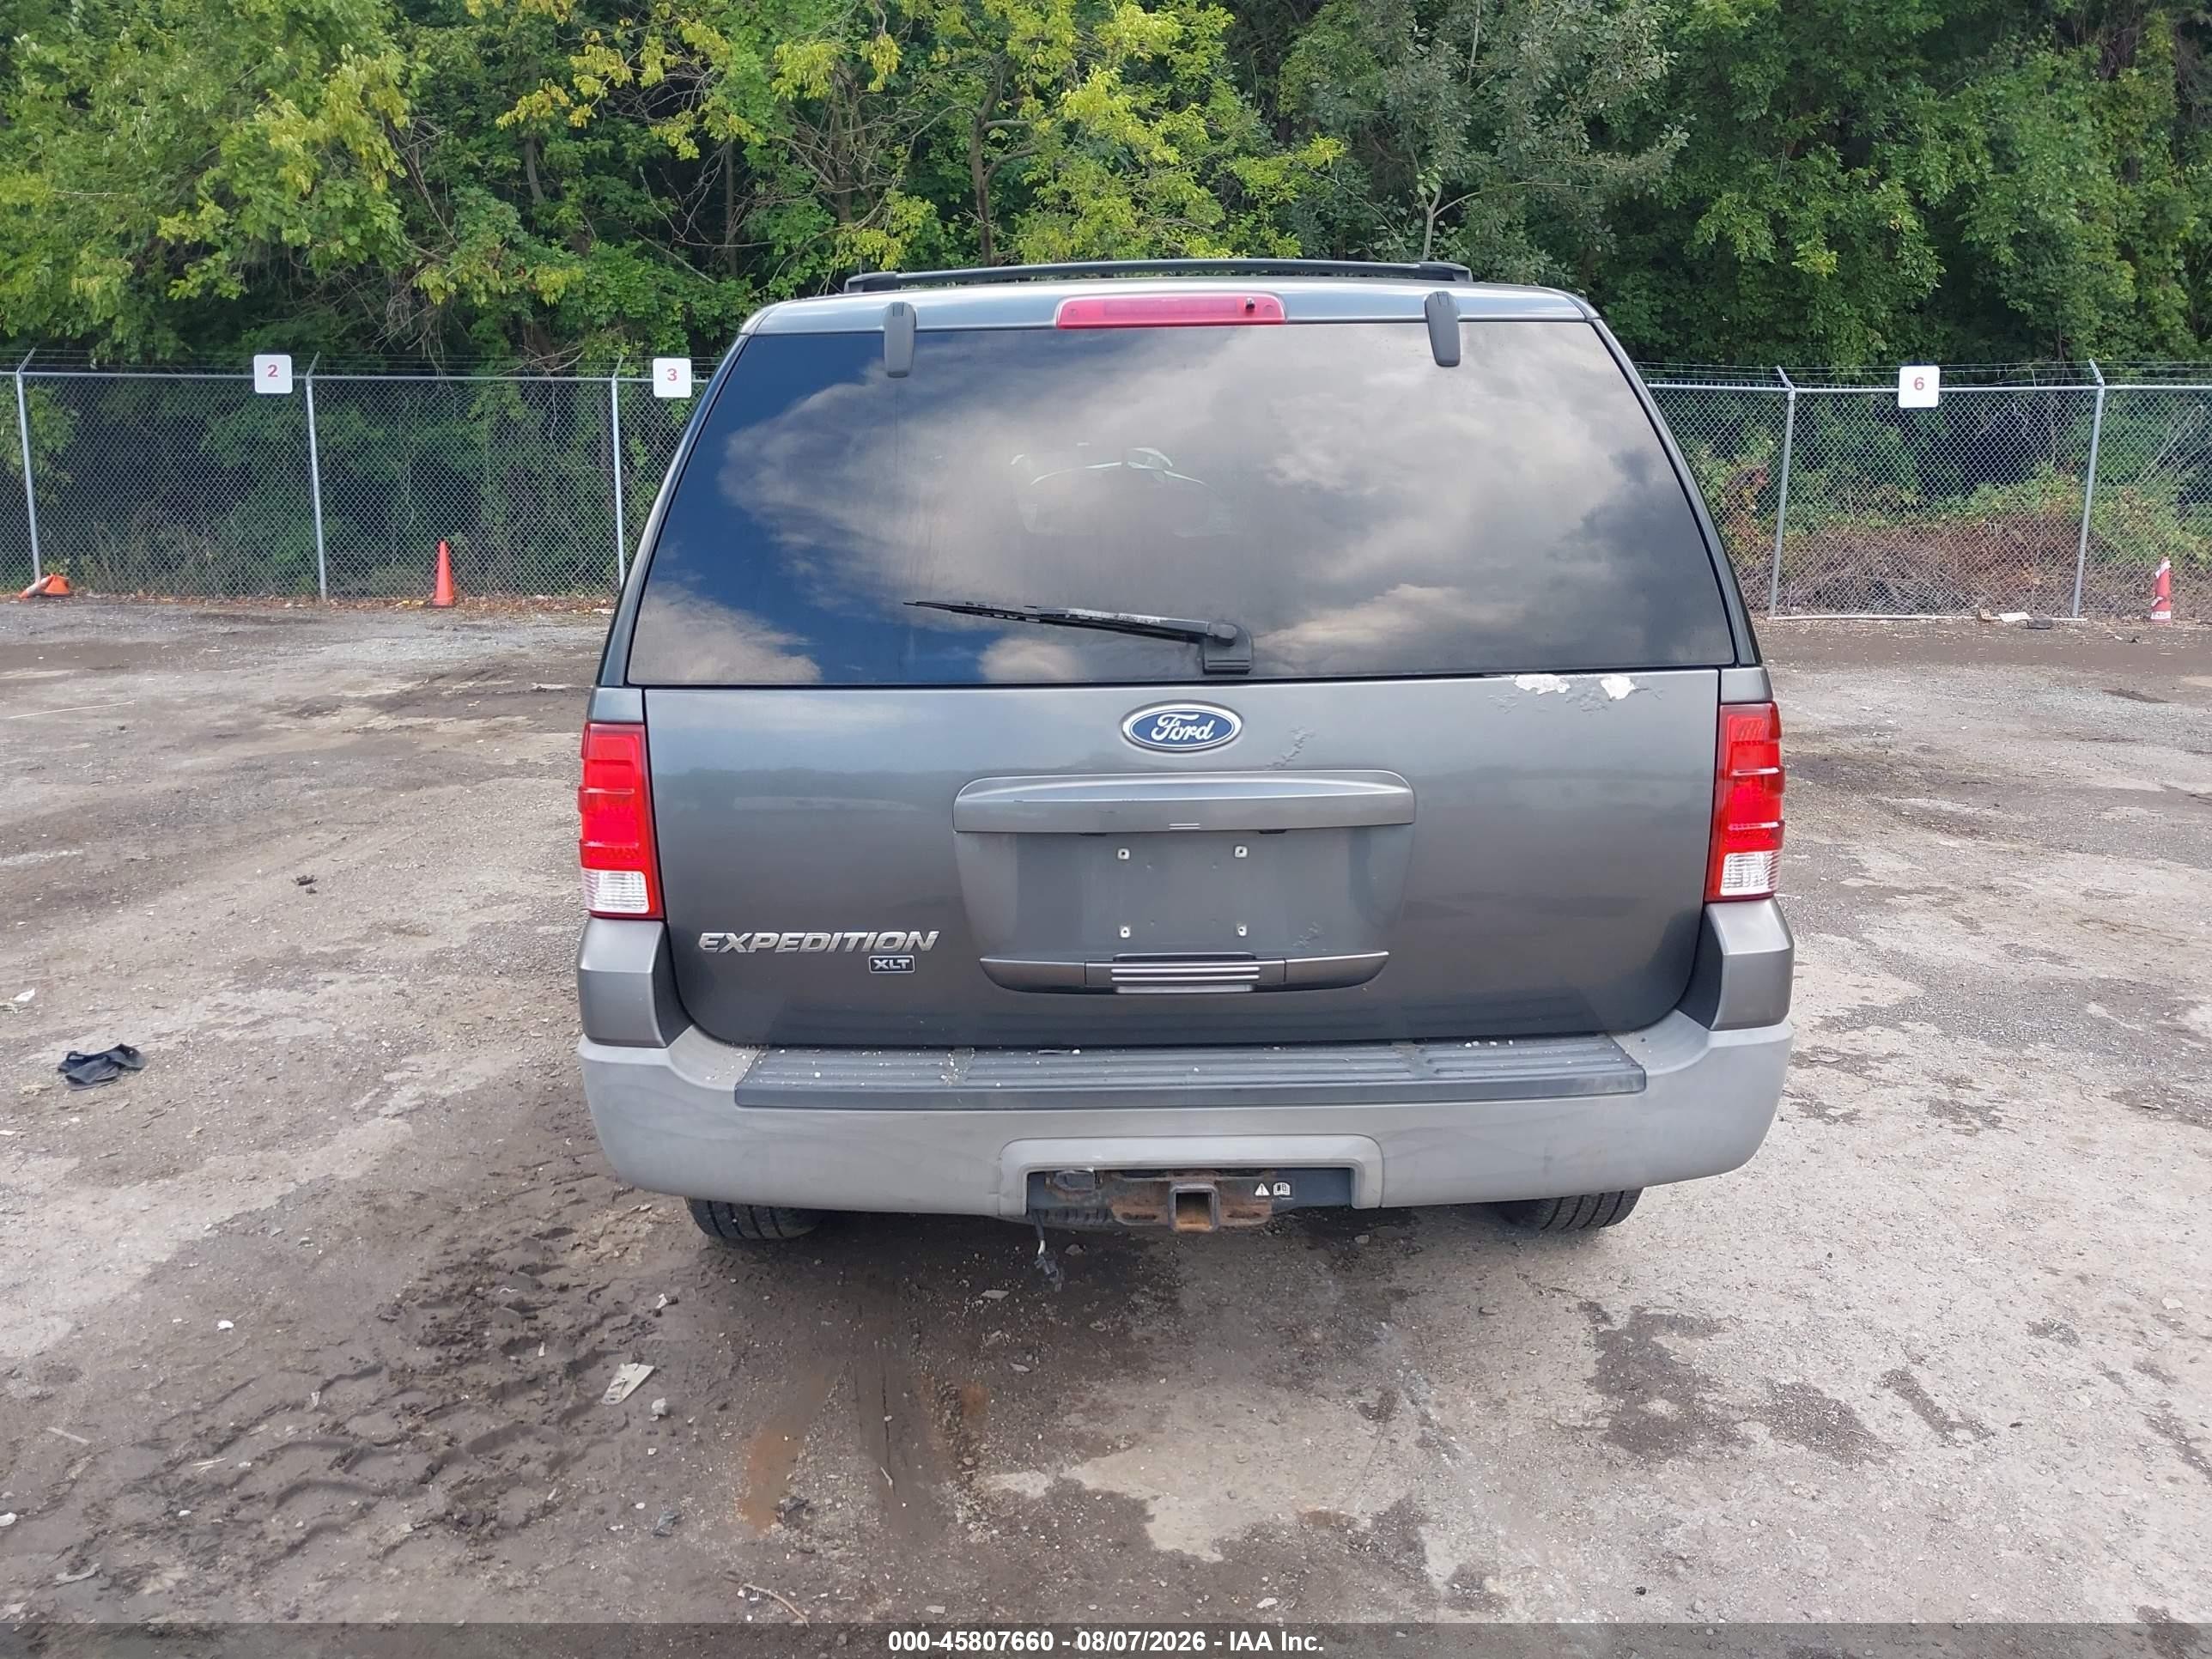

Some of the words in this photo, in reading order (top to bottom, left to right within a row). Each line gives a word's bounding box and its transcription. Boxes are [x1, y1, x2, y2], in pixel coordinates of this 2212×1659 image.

[267, 364, 278, 378] 2
[666, 368, 678, 381] 3
[1914, 376, 1925, 391] 6
[1151, 714, 1214, 741] Ford
[699, 931, 940, 953] EXPEDITION
[872, 958, 910, 970] XLT
